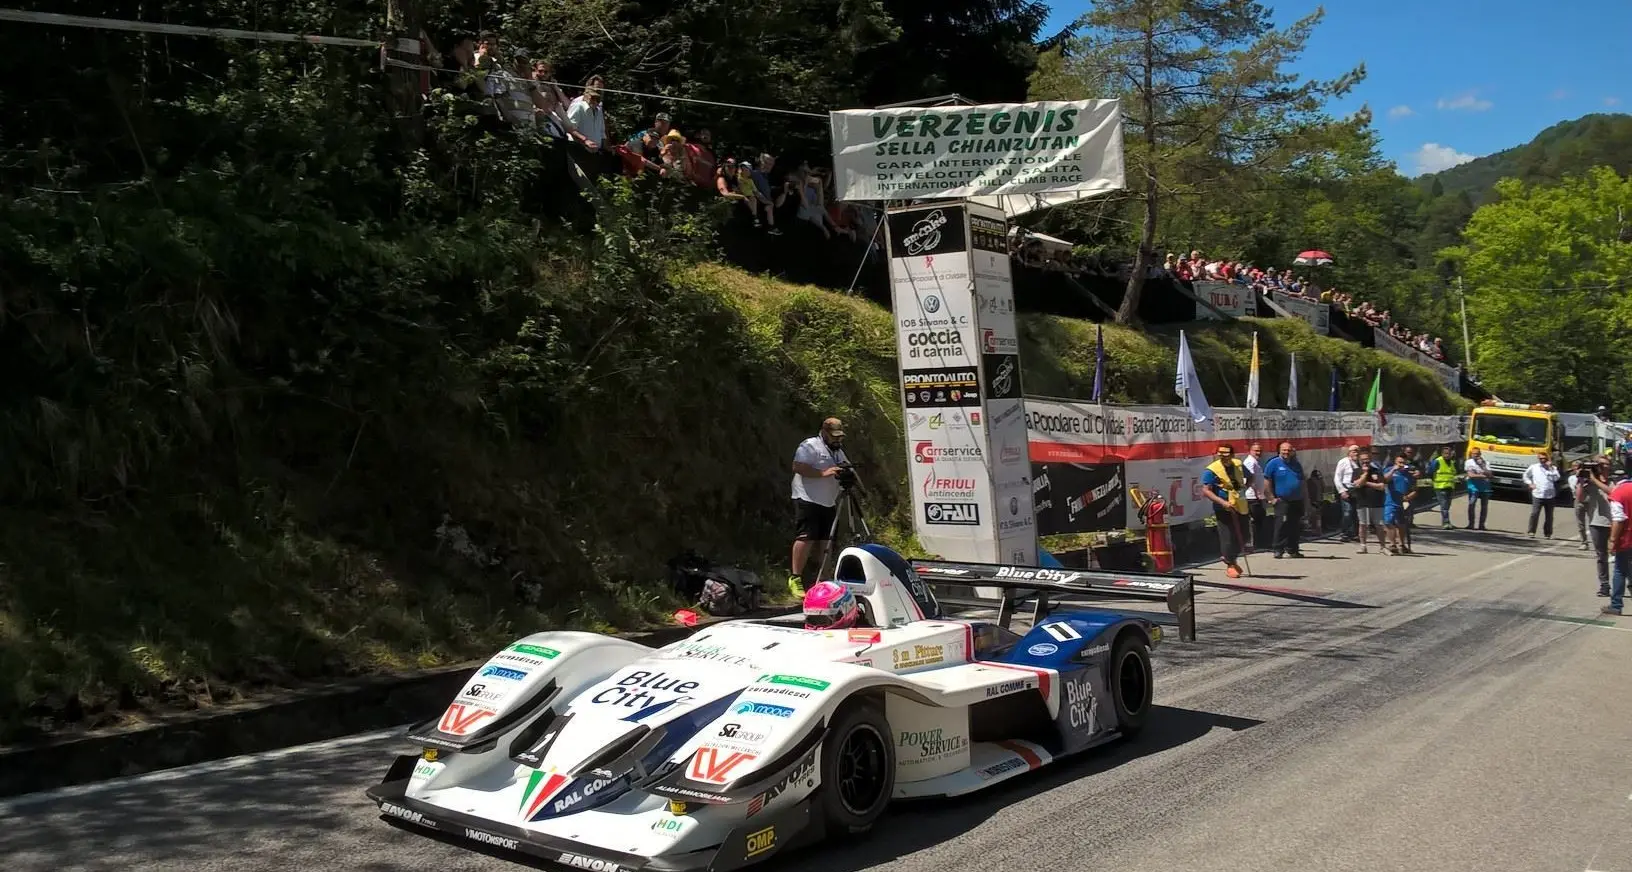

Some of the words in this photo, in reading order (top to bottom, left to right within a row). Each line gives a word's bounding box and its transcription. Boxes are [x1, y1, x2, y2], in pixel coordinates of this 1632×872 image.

[872, 109, 1078, 139] VERZEGNIS
[875, 141, 936, 157] SELLA
[948, 135, 1080, 155] CHIANZUTAN
[876, 160, 924, 170] GARA
[877, 171, 895, 181] DI
[996, 168, 1013, 177] IN
[1022, 164, 1081, 175] SALITA
[877, 179, 974, 190] INTERNATIONAL
[979, 178, 1003, 187] HILL
[1010, 175, 1047, 185] CLIMB
[1052, 174, 1083, 183] RACE
[950, 316, 957, 325] &
[909, 346, 920, 358] di
[923, 346, 962, 357] carnia
[904, 371, 976, 384] PRONTOAUTO
[963, 391, 978, 399] Jeep
[1032, 411, 1080, 435] Popolare
[1083, 413, 1094, 434] di
[1133, 416, 1154, 434] Banca
[936, 478, 976, 490] FRIULI
[928, 489, 975, 498] antincendi
[996, 567, 1034, 579] Blue
[1035, 569, 1076, 584] City
[617, 671, 700, 694] Blue
[986, 686, 999, 697] RAL
[1067, 678, 1092, 704] Blue
[591, 686, 668, 720] City
[1070, 700, 1094, 734] City
[899, 728, 943, 747] POWER
[920, 735, 961, 757] SERVICE
[414, 765, 436, 776] HDI
[763, 750, 817, 807] AVON
[554, 791, 583, 814] RAL
[389, 805, 423, 823] AVON
[656, 818, 684, 832] HDI
[747, 830, 775, 853] OMP
[570, 854, 620, 872] AVON
